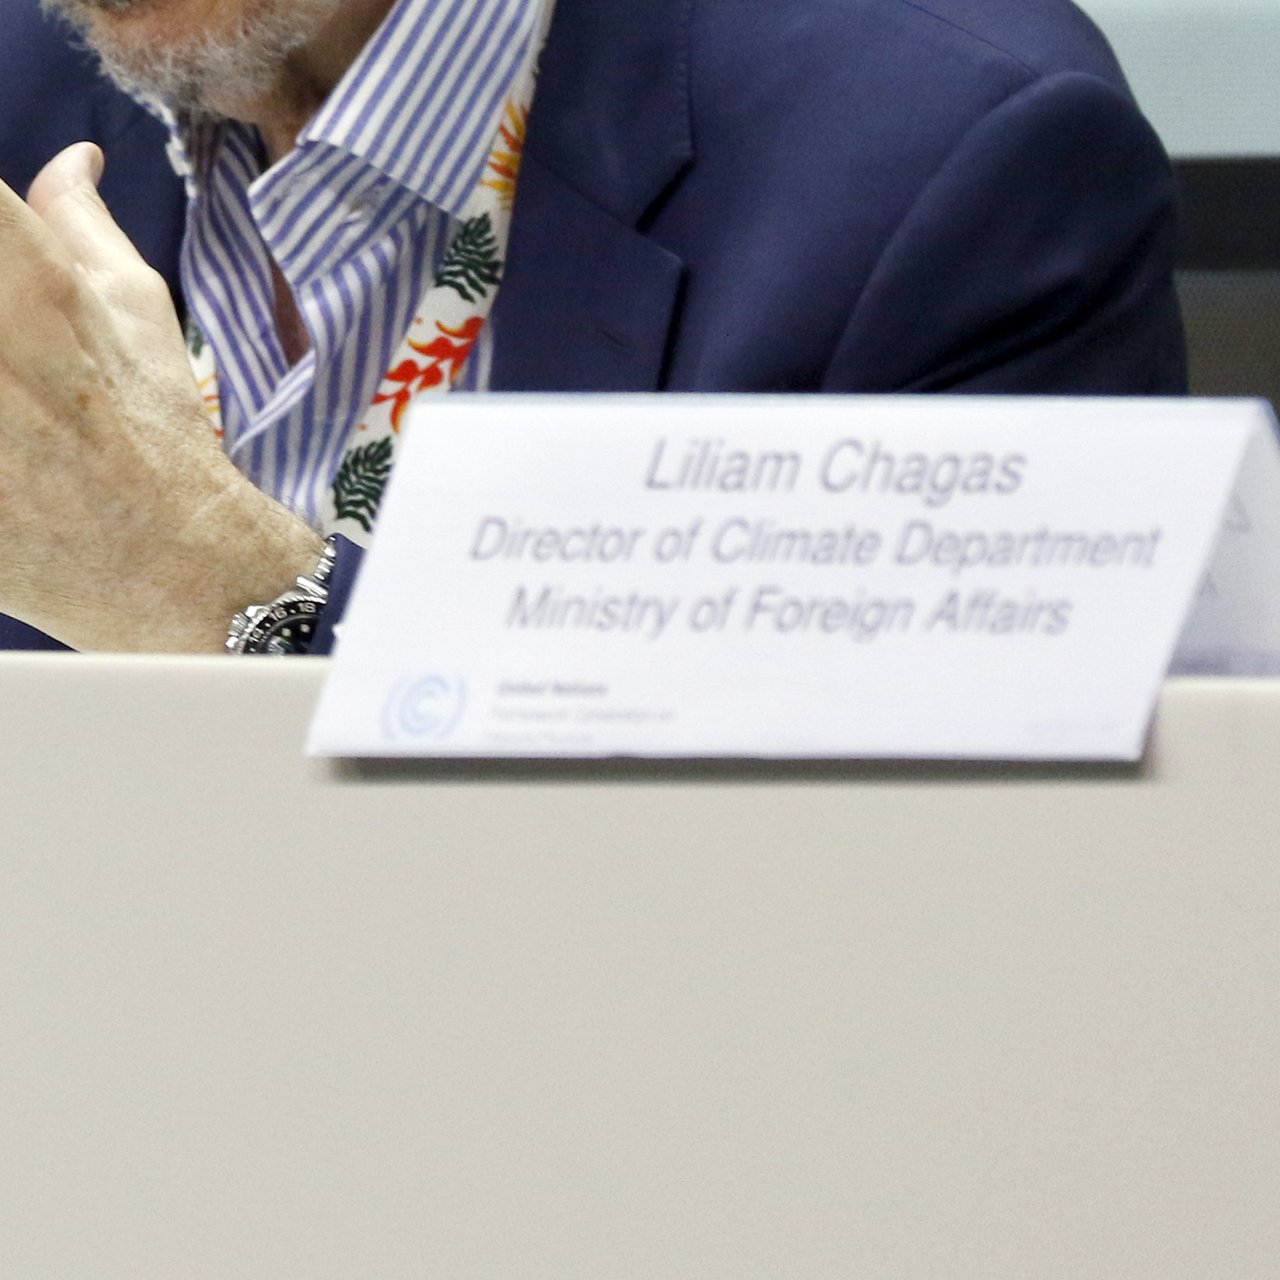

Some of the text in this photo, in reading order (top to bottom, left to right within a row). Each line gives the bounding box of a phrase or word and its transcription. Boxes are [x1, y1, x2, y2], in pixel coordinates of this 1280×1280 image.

[643, 437, 1028, 509] Liliam Chagas
[469, 516, 1163, 575] Director of Climate Department
[506, 585, 1073, 644] Ministry of Foreign Affairs
